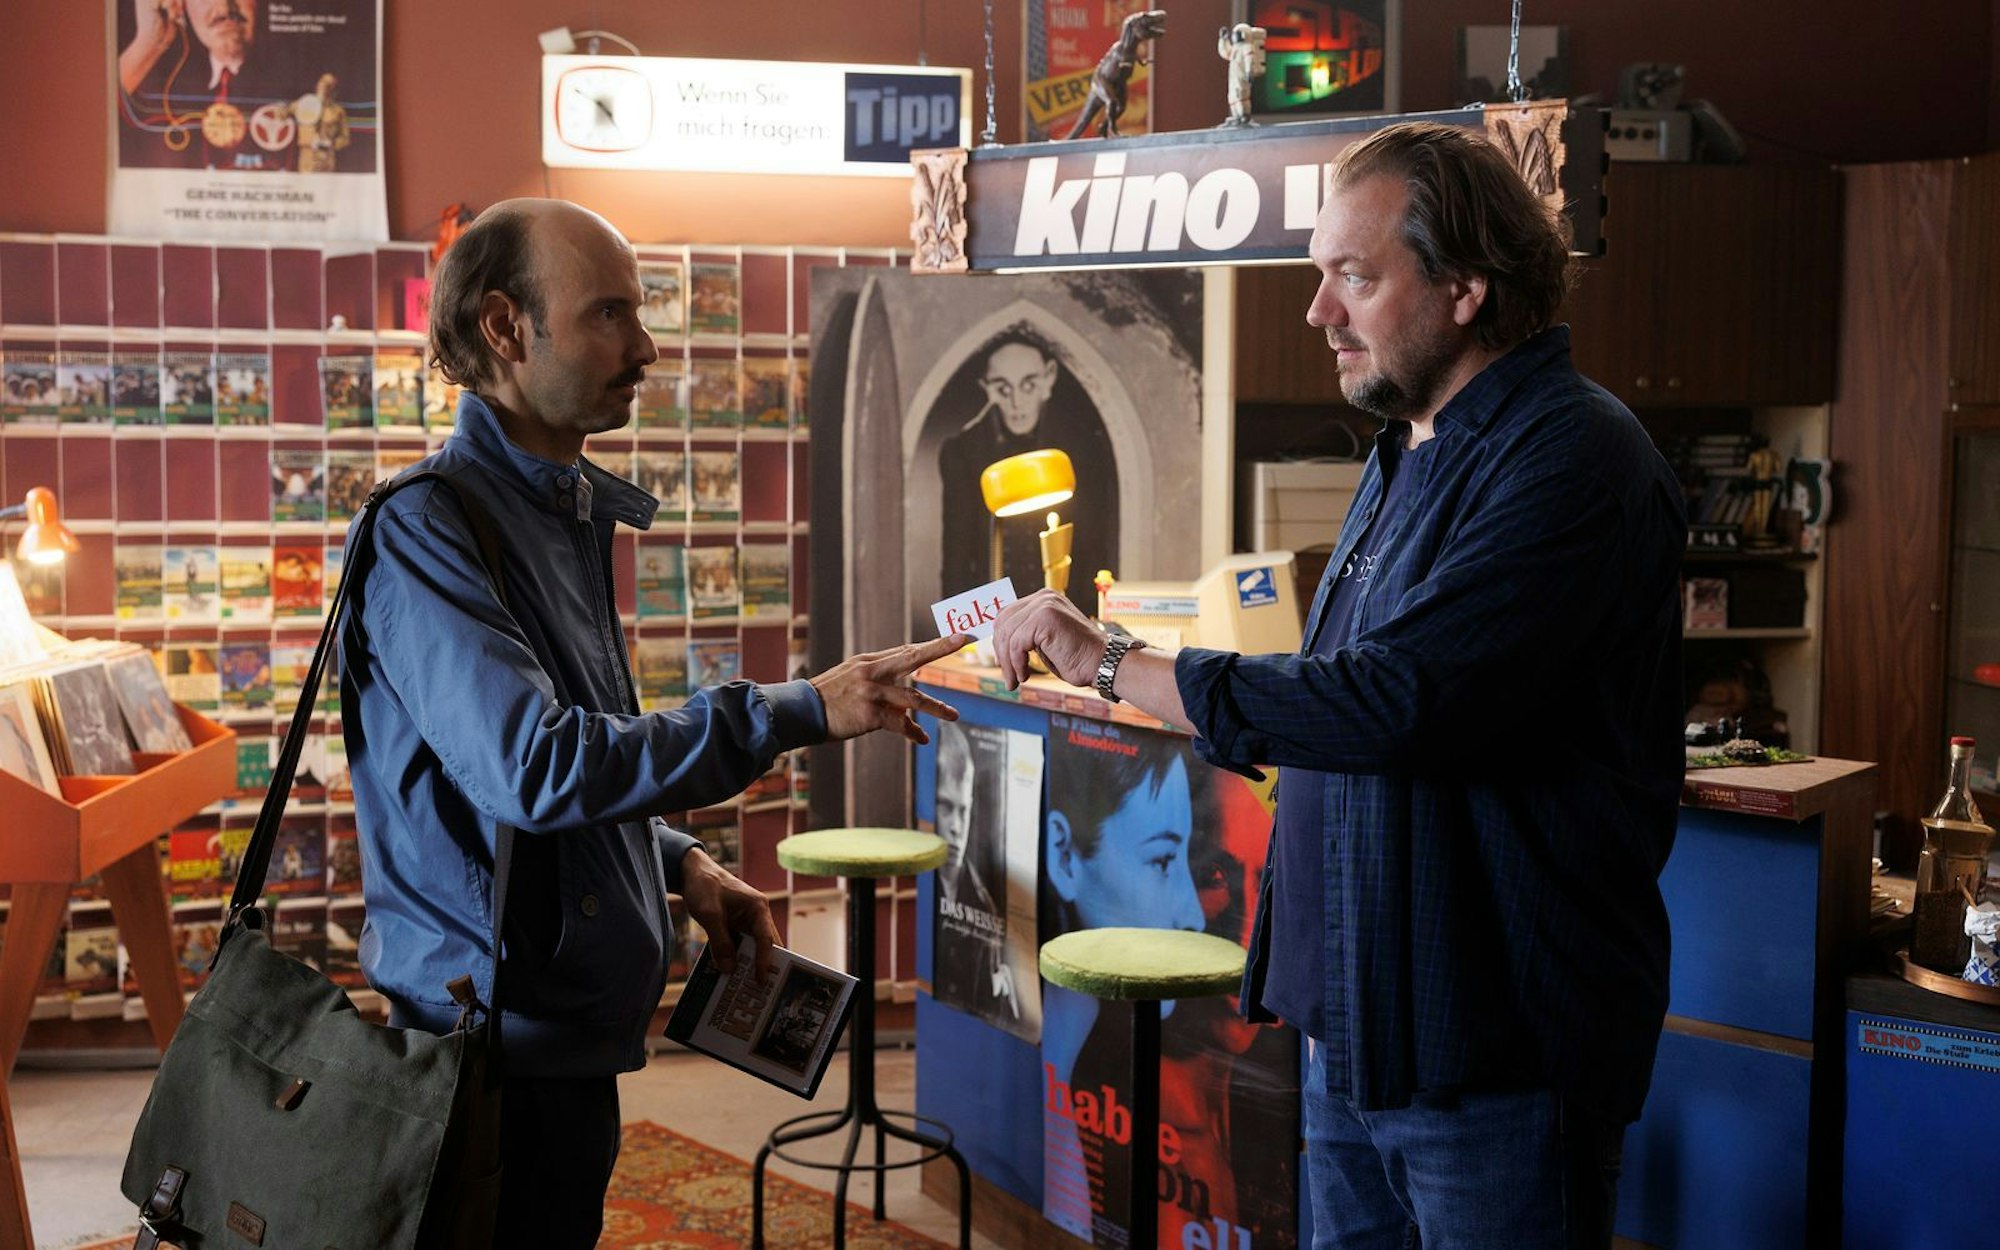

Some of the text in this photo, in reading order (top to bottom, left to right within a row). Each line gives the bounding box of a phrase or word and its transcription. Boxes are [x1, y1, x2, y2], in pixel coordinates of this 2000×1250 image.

[676, 83, 955, 148] Wenn Sie Tipp
[676, 117, 734, 139] mich
[1014, 152, 1260, 257] kino
[945, 596, 1003, 635] fakt
[940, 897, 964, 921] DAS
[1865, 1029, 1921, 1051] KINO
[1045, 1064, 1182, 1166] habe
